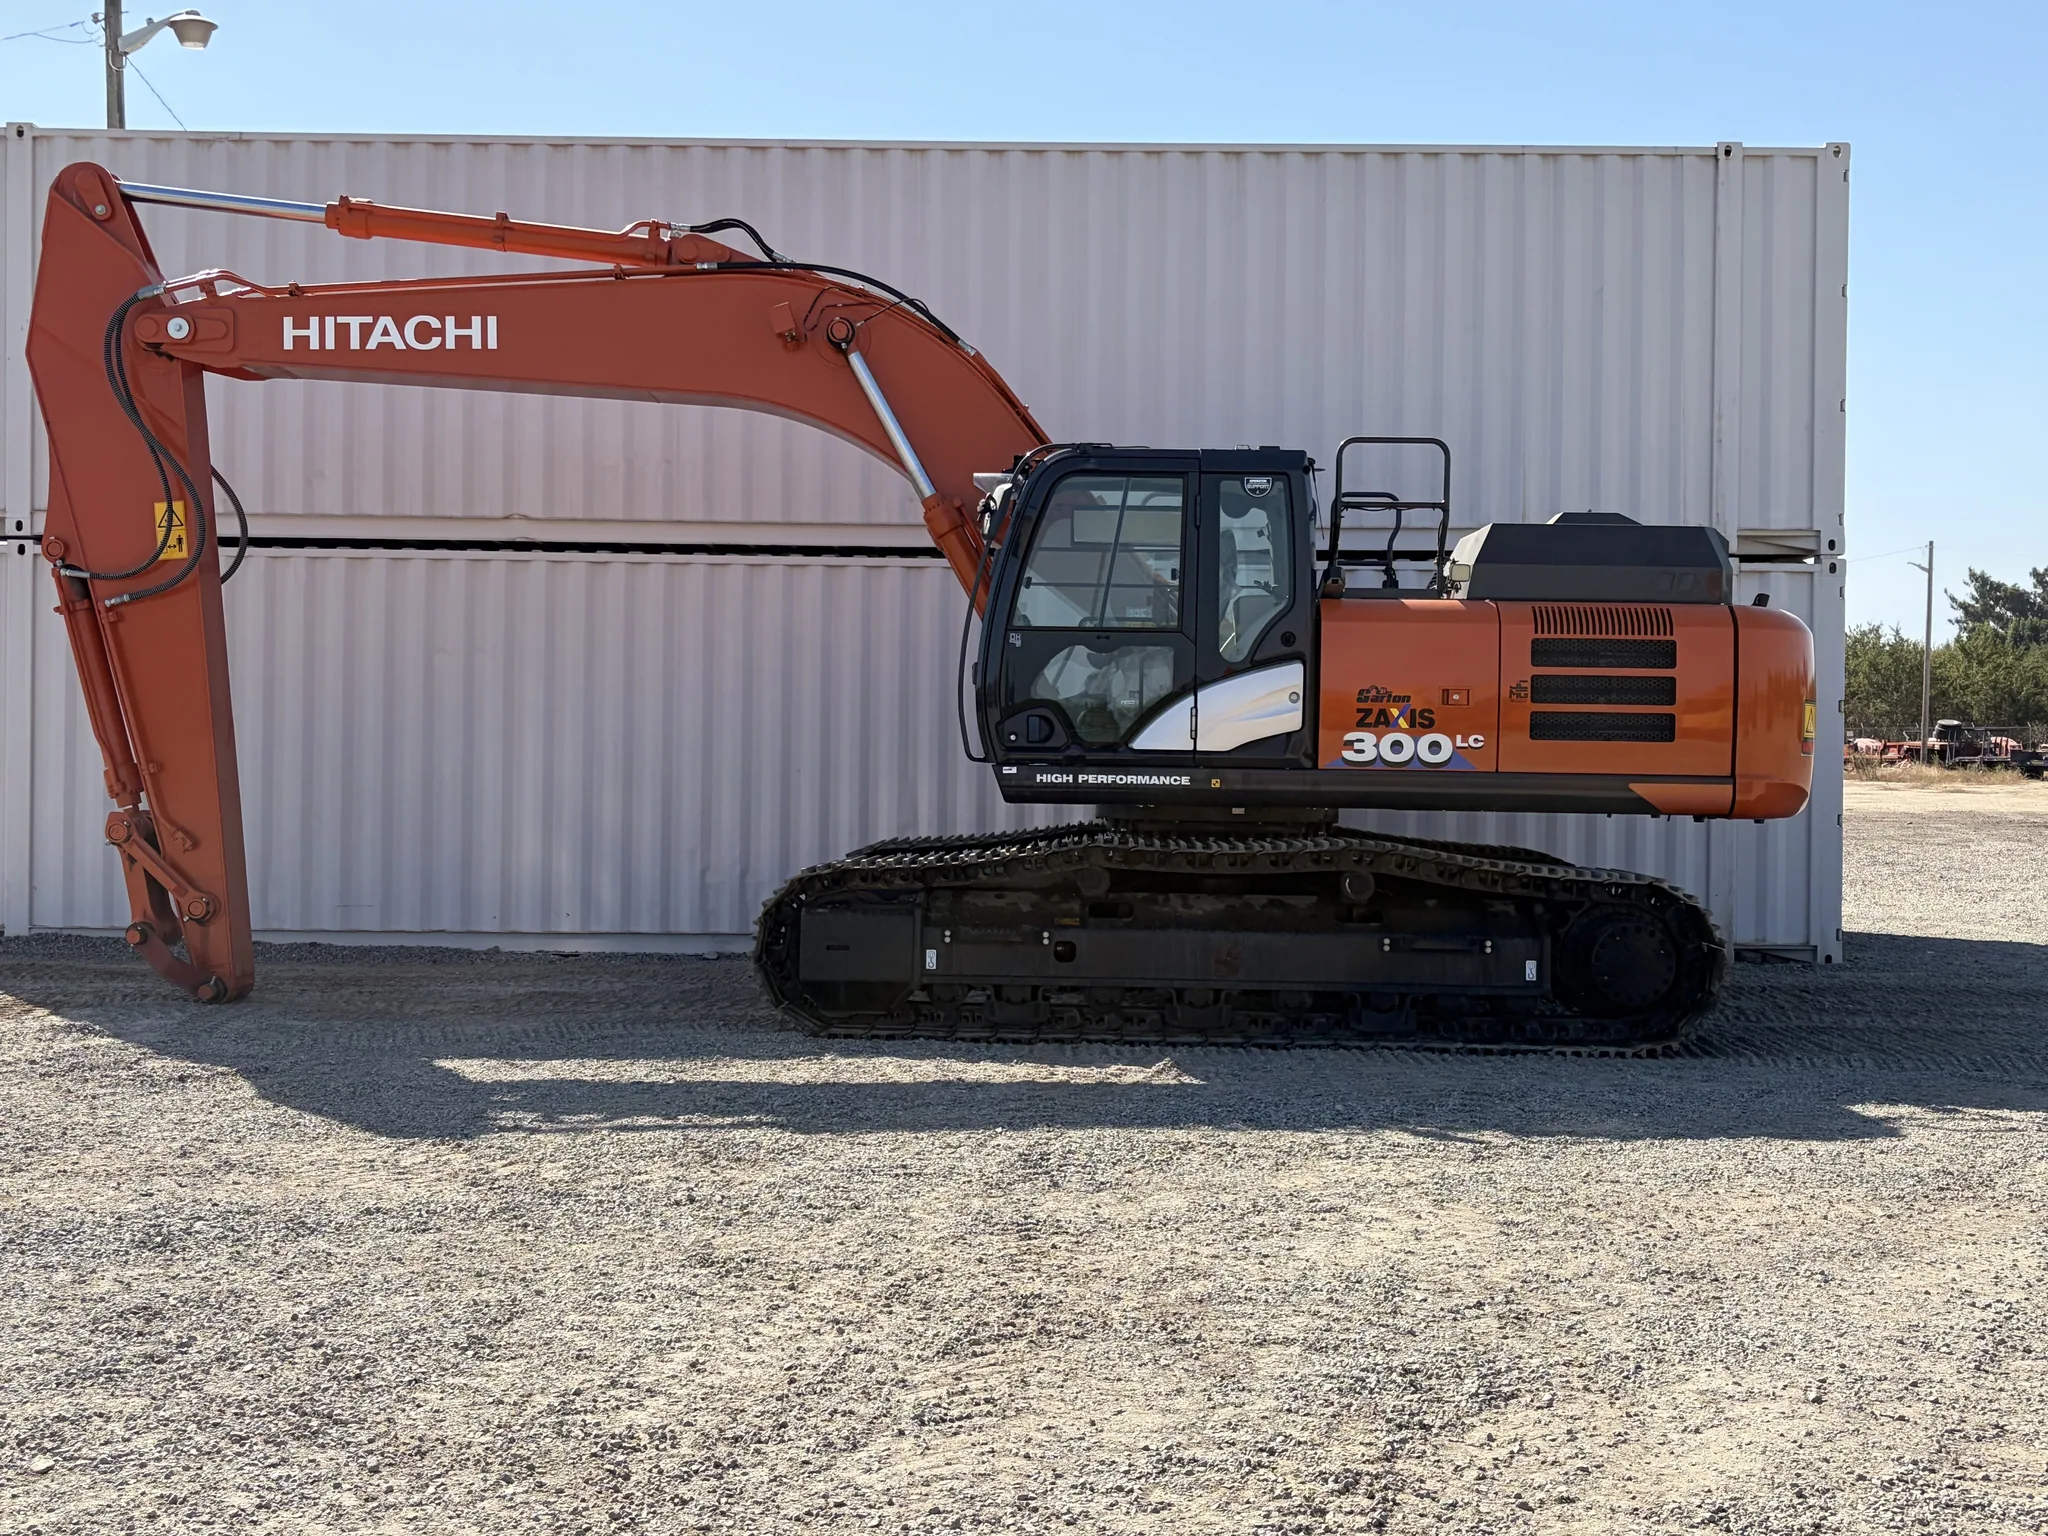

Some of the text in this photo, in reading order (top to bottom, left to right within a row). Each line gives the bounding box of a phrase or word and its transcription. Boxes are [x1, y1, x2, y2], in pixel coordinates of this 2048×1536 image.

[283, 315, 498, 350] HITACHI
[1355, 704, 1436, 729] ZAXIS
[1341, 731, 1485, 766] 300 LC
[1036, 773, 1191, 785] HIGH PERFORMANCE
